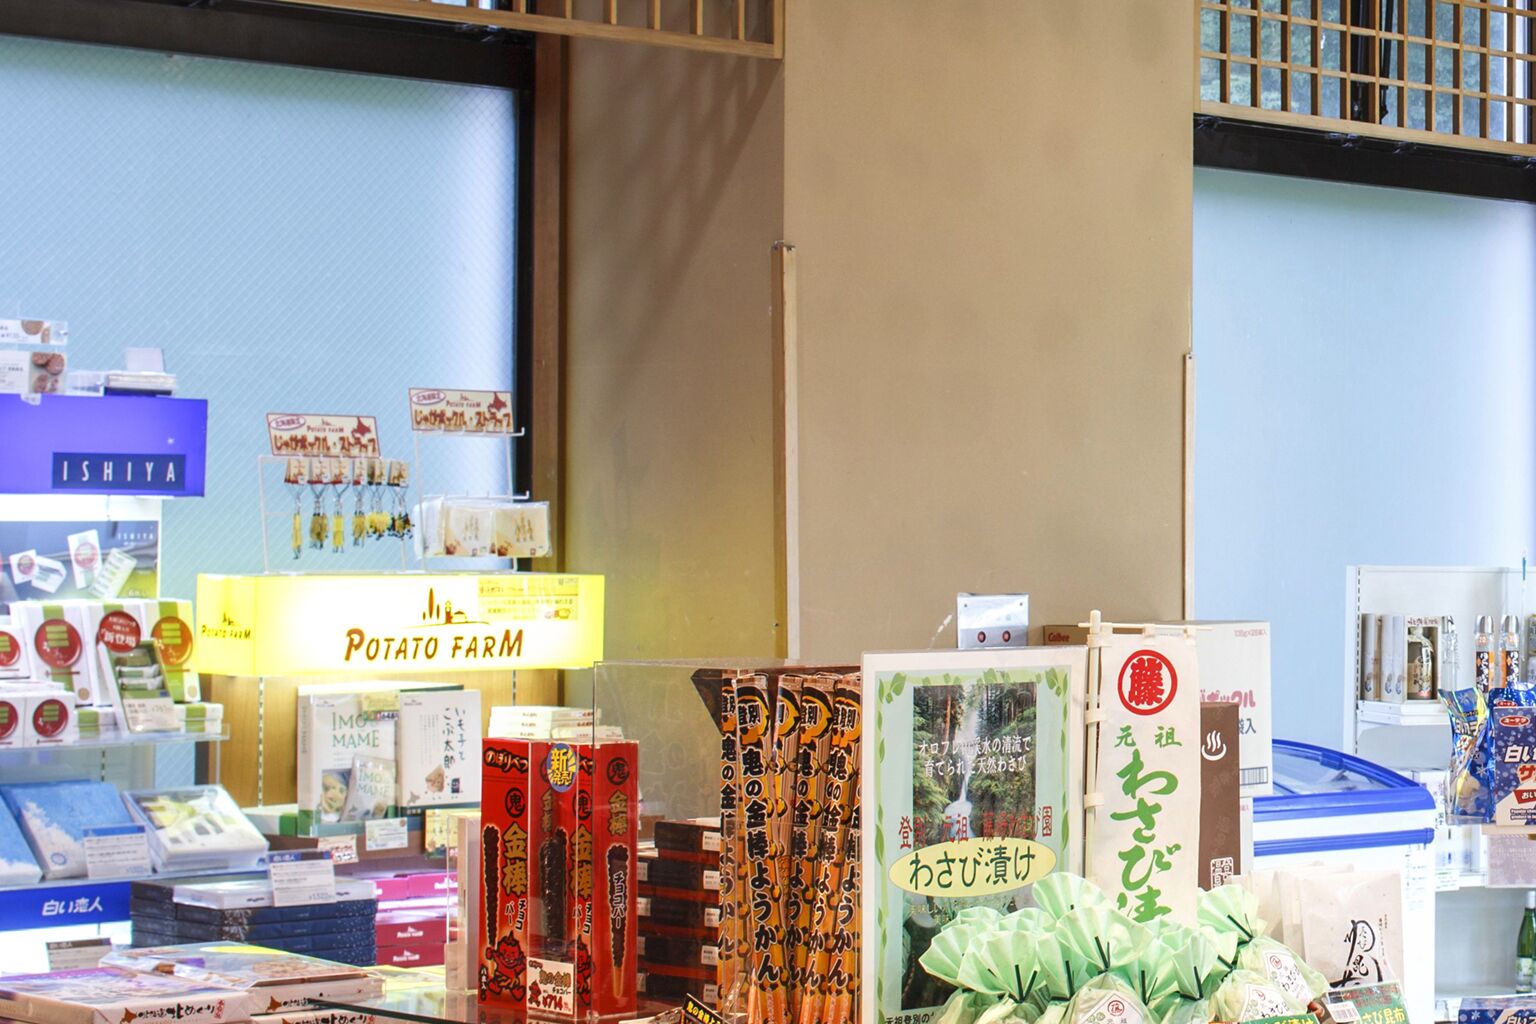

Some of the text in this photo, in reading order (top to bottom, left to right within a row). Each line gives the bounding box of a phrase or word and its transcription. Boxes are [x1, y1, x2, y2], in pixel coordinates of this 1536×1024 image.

[62, 460, 176, 482] ISHIYA
[344, 628, 524, 662] POTATO FARM
[332, 730, 380, 749] MAME
[1113, 725, 1183, 749] 元祖
[502, 821, 528, 897] 金棒
[741, 746, 781, 984] 鬼の金棒ようかん
[909, 845, 1037, 891] わさび漬け
[41, 895, 104, 917] 白い恋人
[611, 870, 626, 930] チョコバー
